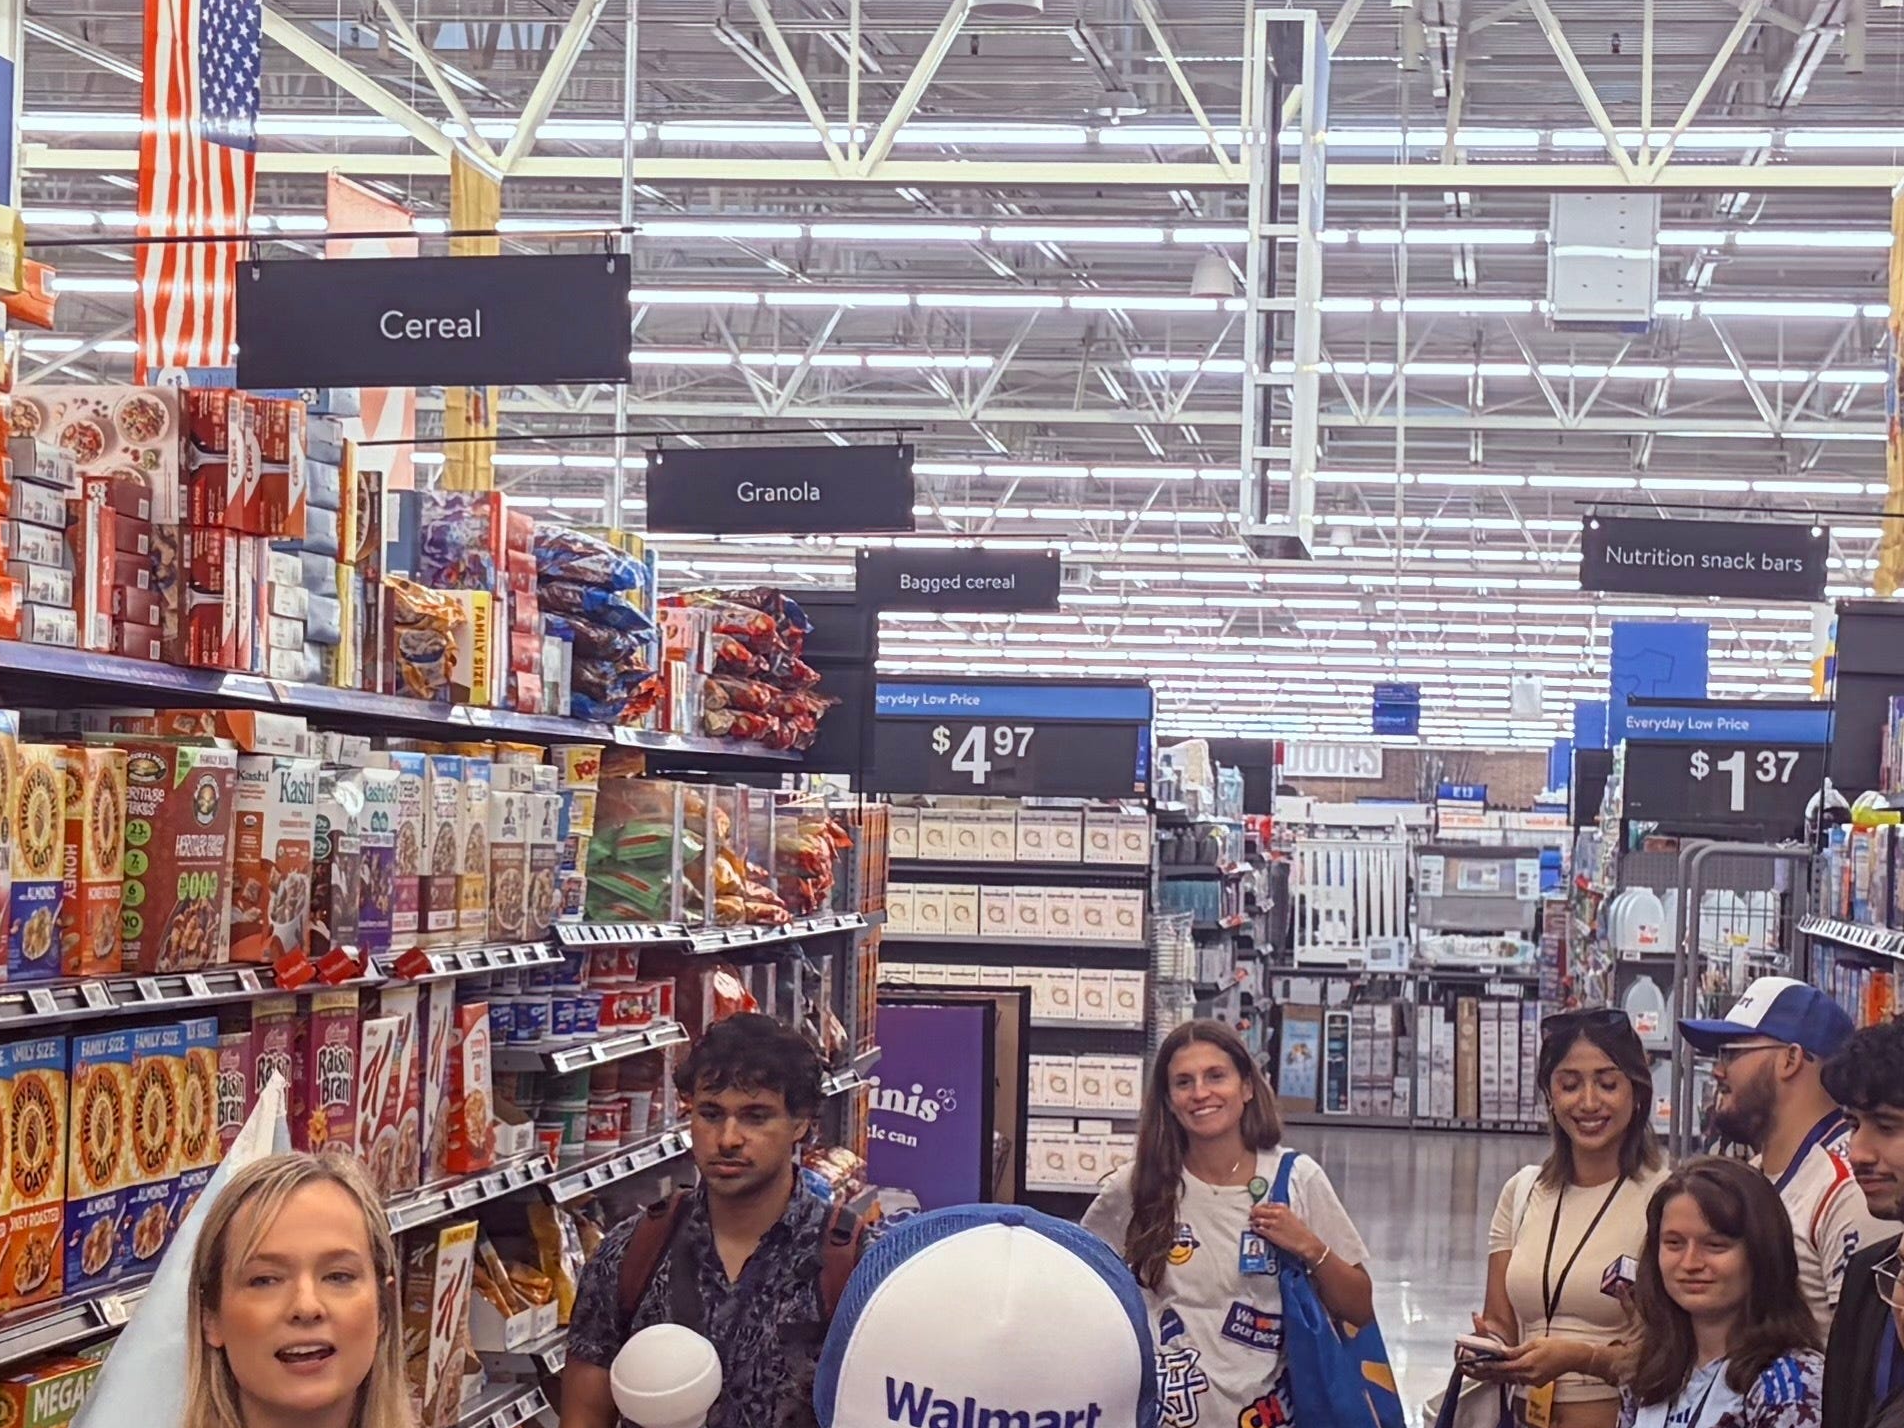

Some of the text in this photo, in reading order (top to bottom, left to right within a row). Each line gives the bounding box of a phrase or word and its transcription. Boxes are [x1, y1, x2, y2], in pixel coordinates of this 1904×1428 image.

[380, 310, 482, 340] Cereal
[737, 482, 821, 504] Granola
[1605, 546, 1802, 572] Nutrition snack bars
[900, 574, 1015, 591] Bagged cereal
[473, 606, 485, 687] FAMILY SIZE
[876, 693, 980, 706] eryday Low Price
[1625, 715, 1749, 732] Everyday Low Price
[279, 771, 314, 804] Kashi
[64, 843, 78, 899] HONEY
[216, 1071, 246, 1098] Raisin
[869, 1075, 940, 1122] inis
[217, 1098, 244, 1127] Bran
[888, 1132, 917, 1148] can
